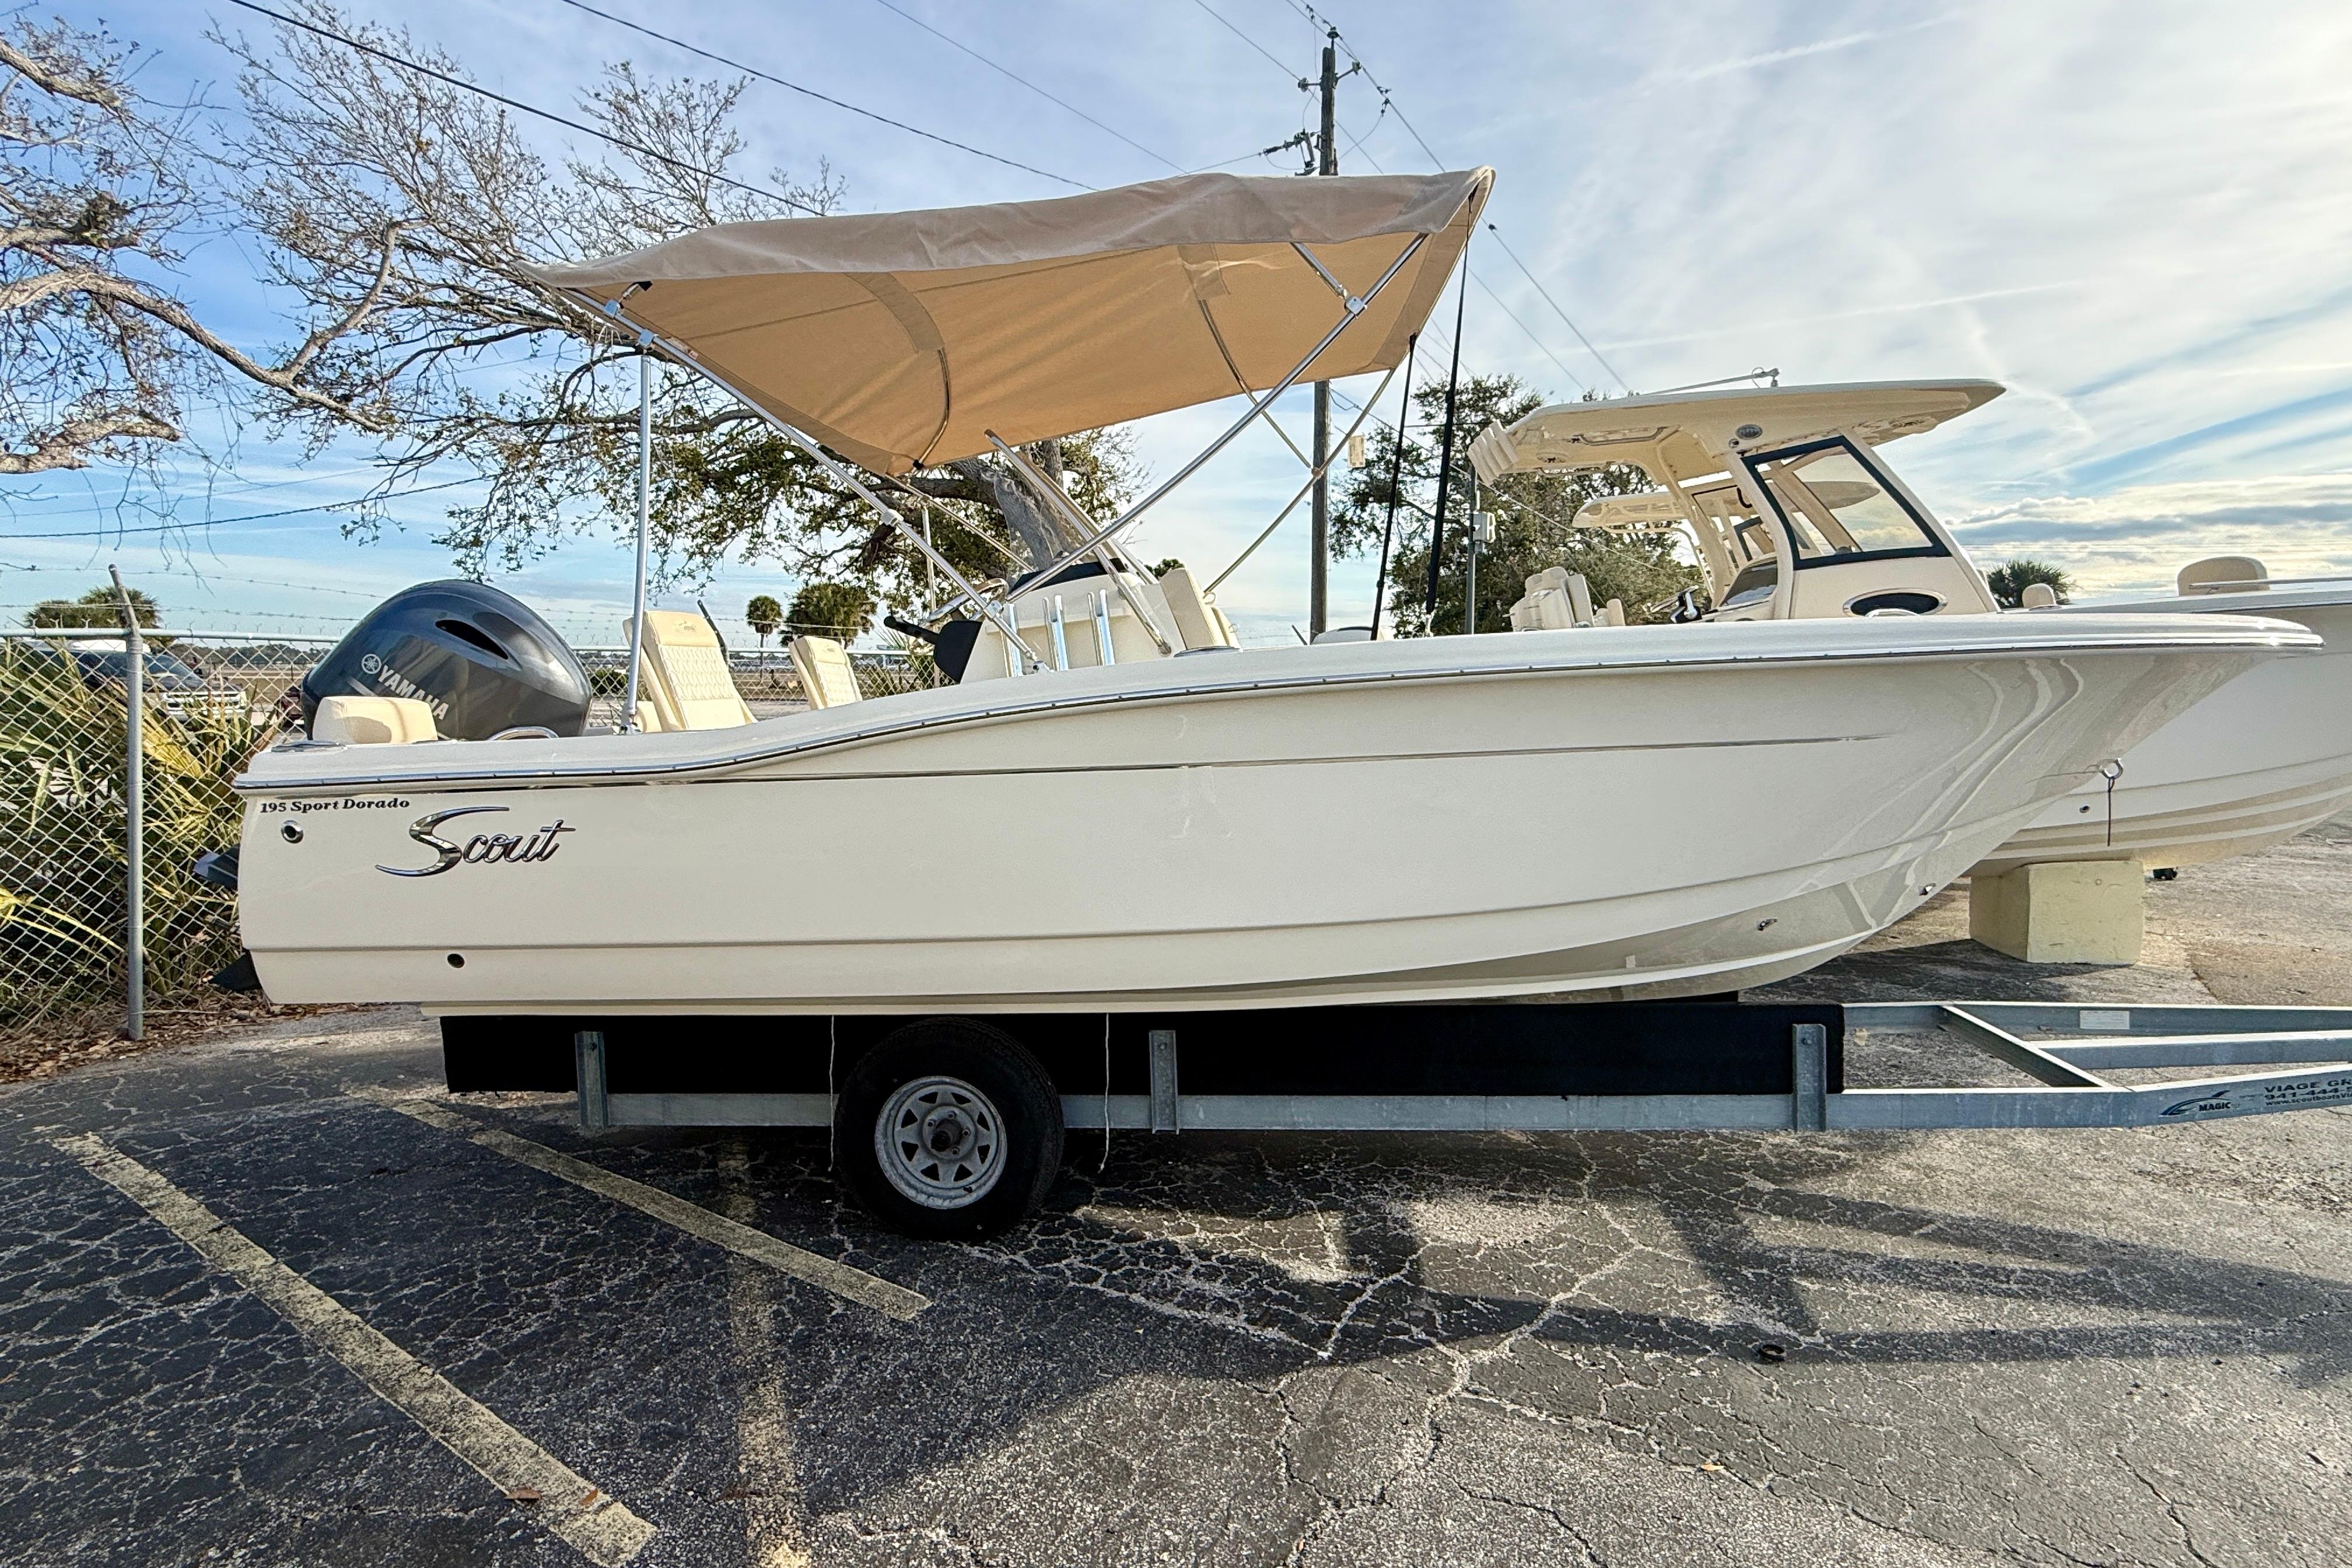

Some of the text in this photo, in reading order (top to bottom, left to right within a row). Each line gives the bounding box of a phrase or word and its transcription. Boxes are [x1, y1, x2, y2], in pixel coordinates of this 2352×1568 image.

[260, 798, 410, 813] 195 Sport Dorado
[375, 807, 576, 876] Scout
[2199, 1101, 2231, 1111] MAGIC
